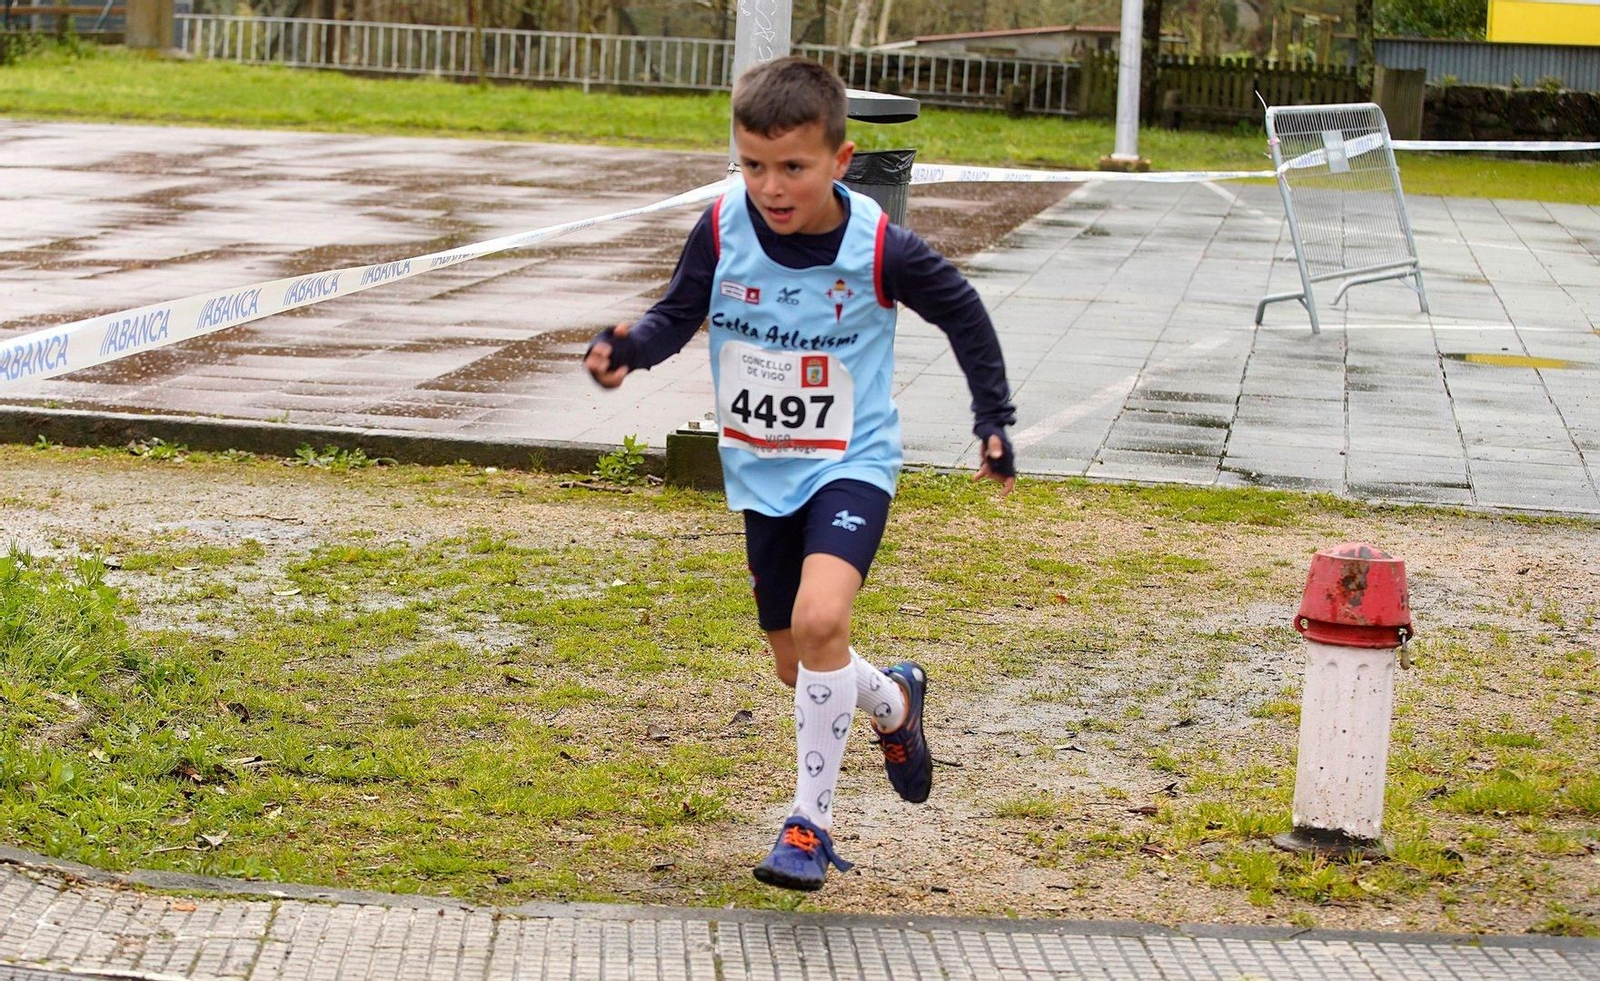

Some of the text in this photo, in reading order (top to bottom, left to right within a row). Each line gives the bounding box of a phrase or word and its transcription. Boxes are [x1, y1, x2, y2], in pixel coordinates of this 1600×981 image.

[0, 334, 69, 380] ABANCA
[105, 309, 171, 355] ABANCA
[202, 288, 262, 328] ABANCA
[287, 272, 341, 305] ABANCA
[712, 313, 759, 339] Celta
[742, 354, 792, 371] CONCELLO
[747, 366, 785, 382] DE VIGO
[731, 388, 834, 429] 4497
